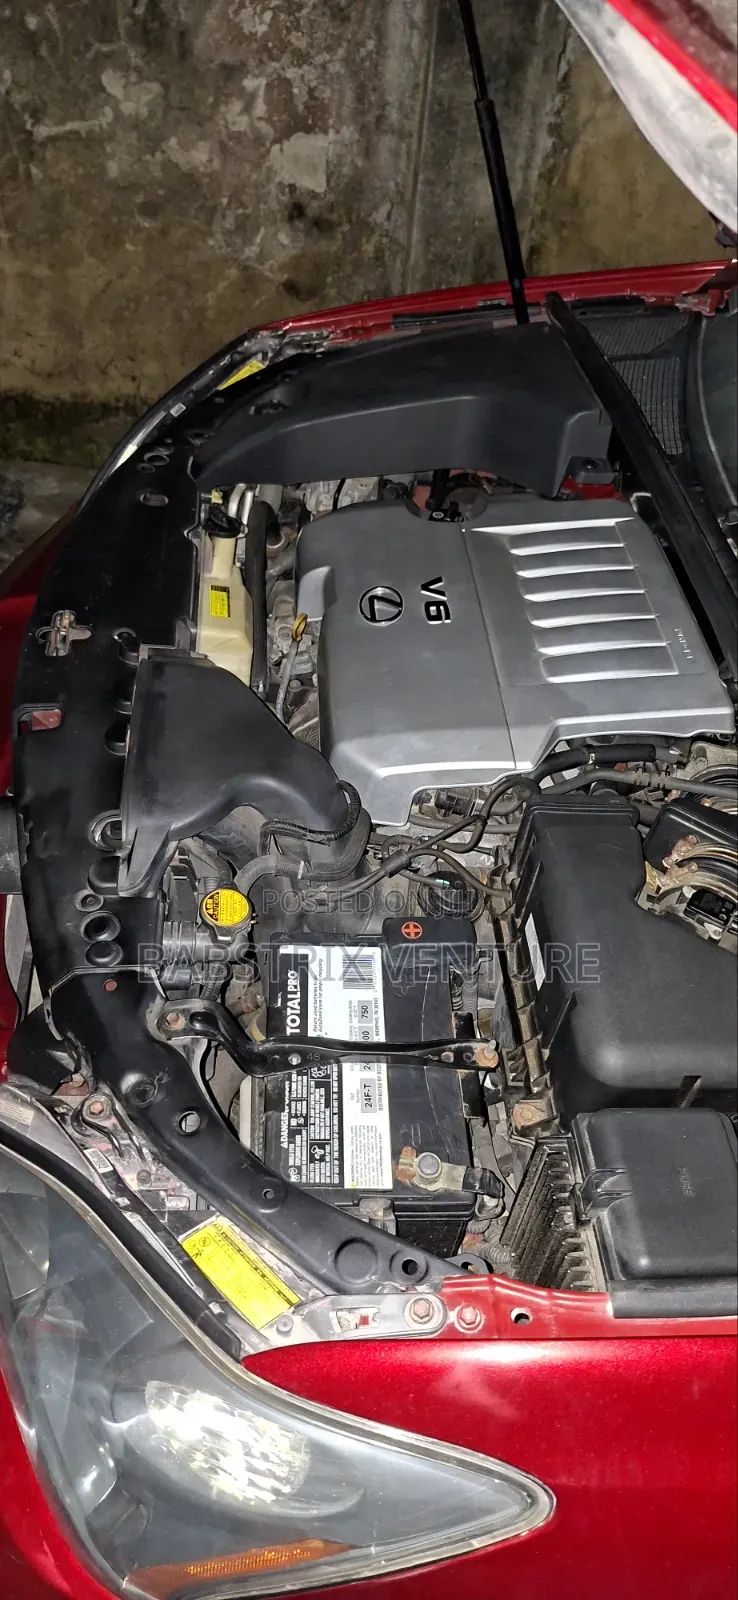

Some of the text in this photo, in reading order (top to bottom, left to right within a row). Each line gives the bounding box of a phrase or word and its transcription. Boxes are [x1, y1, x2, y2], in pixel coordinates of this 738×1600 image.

[420, 576, 452, 625] V6
[286, 970, 301, 1036] TOTALPRO
[361, 1005, 370, 1019] 750
[363, 1083, 373, 1108] 24F-T
